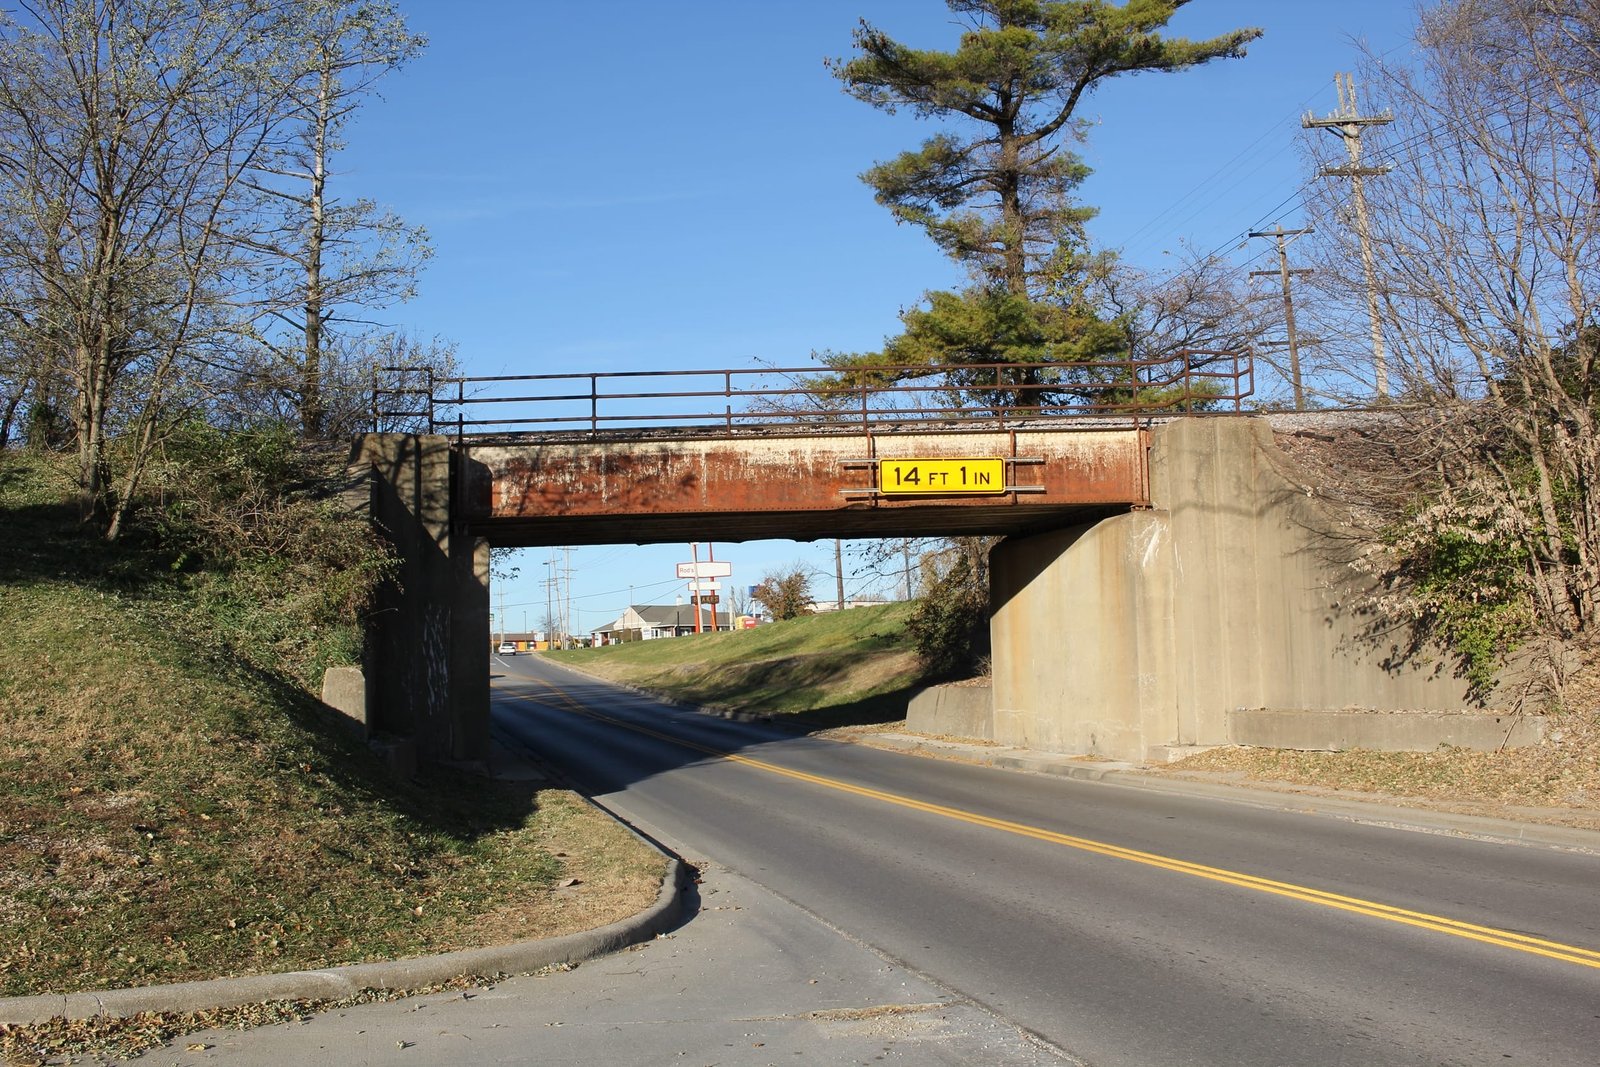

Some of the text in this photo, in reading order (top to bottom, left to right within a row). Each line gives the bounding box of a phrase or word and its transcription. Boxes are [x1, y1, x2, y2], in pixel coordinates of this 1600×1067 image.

[894, 466, 990, 486] 14 FT 1 IN
